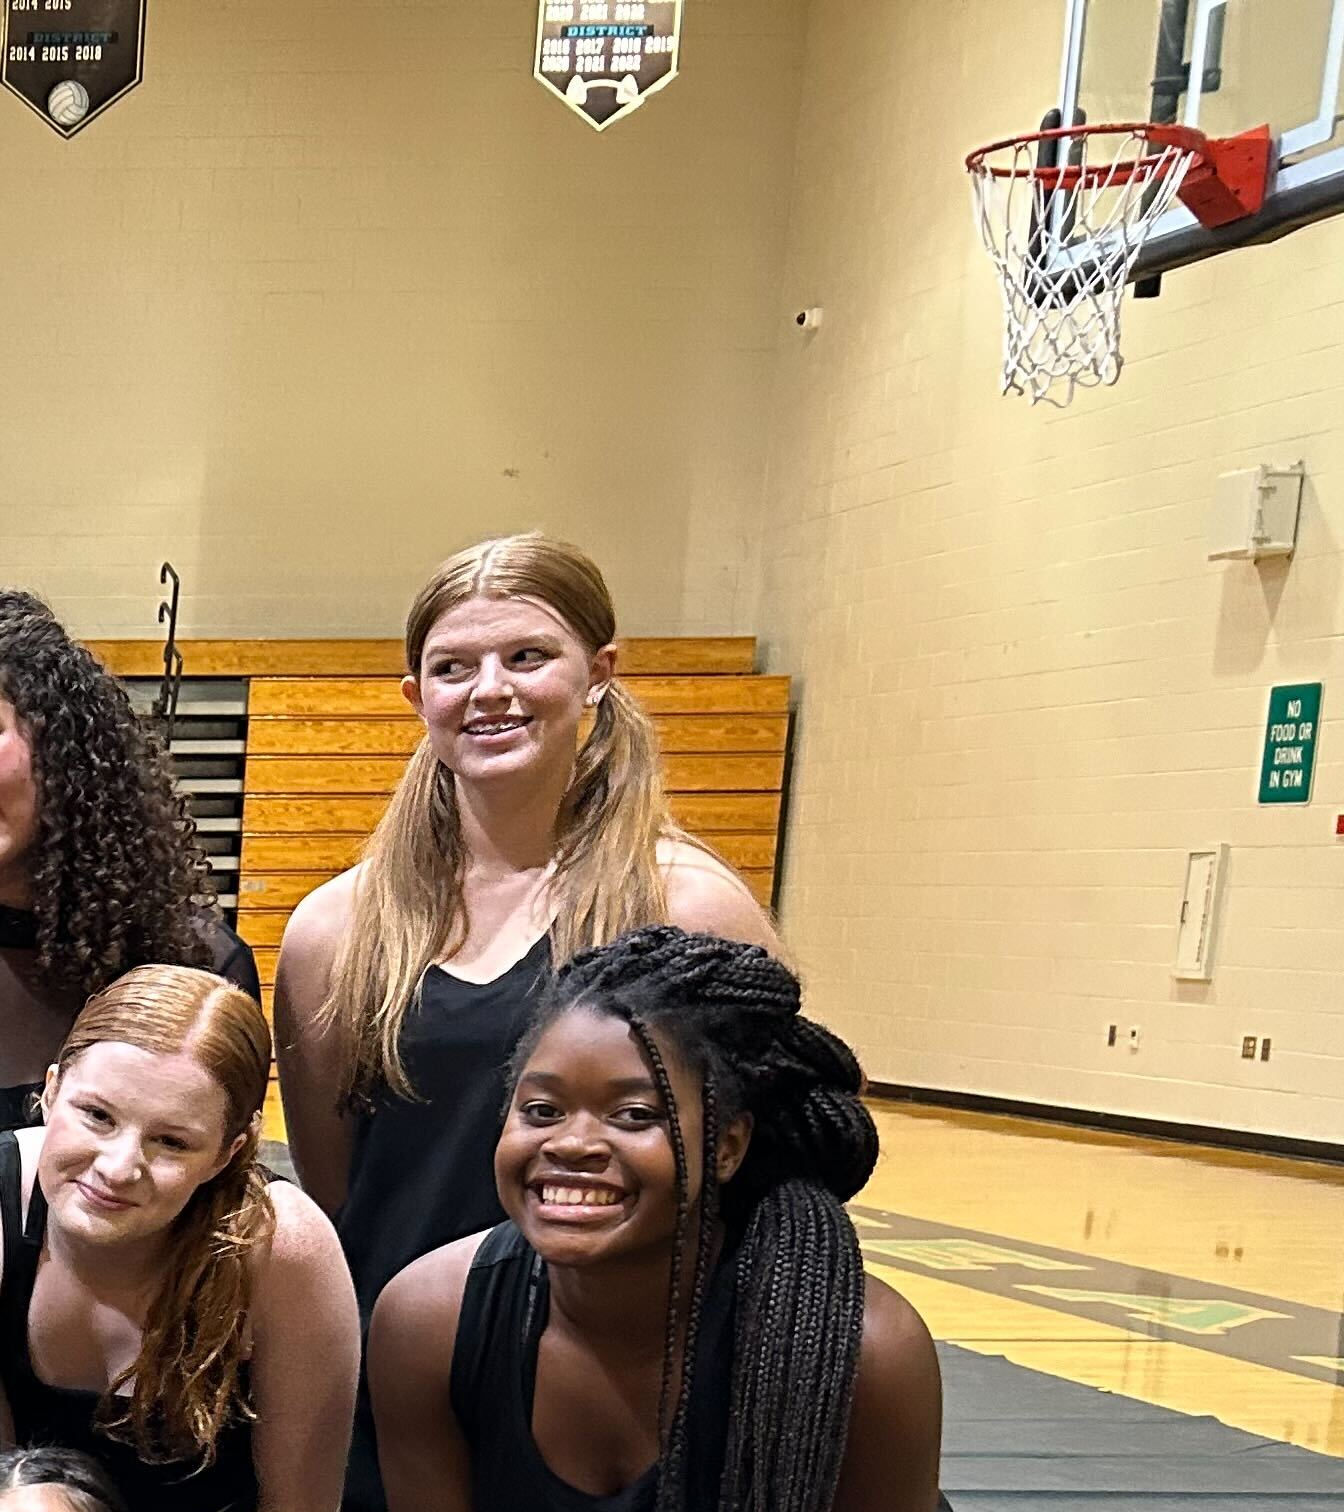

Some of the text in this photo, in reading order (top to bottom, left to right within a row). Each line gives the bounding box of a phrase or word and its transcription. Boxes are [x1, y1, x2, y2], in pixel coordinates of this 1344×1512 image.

[33, 33, 111, 43] DISTRICT
[567, 25, 648, 37] DISTRICT
[10, 45, 102, 61] 2014 2015 2018
[1287, 700, 1302, 718] NO
[1270, 722, 1313, 742] FOOD OR
[1274, 746, 1304, 765] DRINK
[1269, 769, 1303, 788] IN GYM
